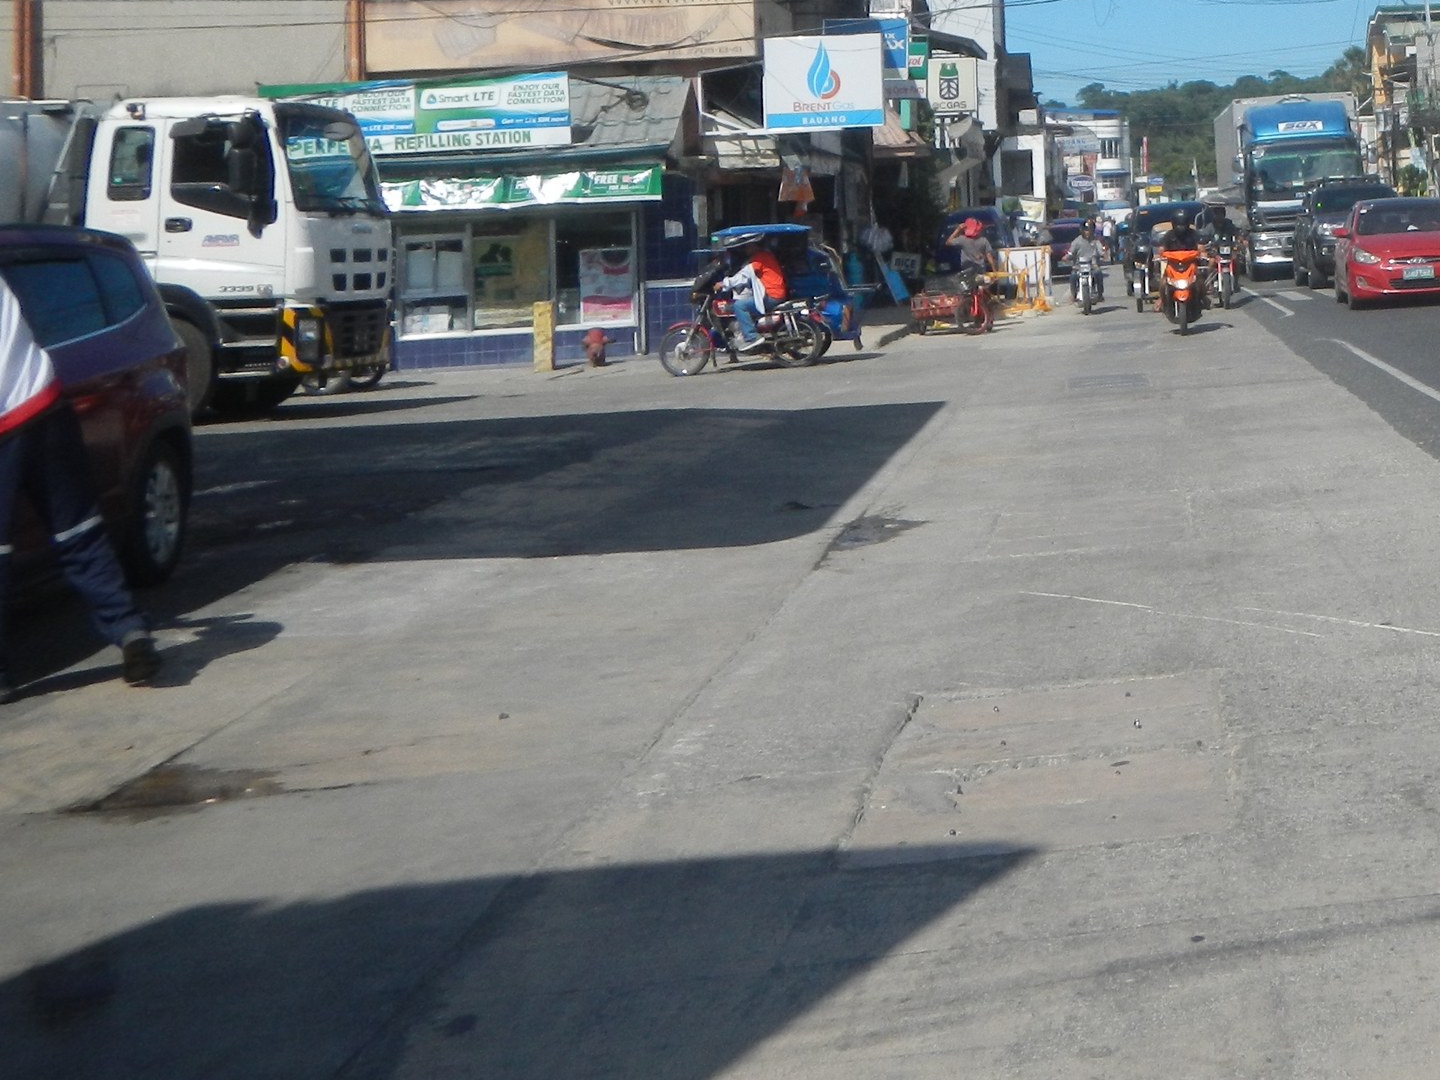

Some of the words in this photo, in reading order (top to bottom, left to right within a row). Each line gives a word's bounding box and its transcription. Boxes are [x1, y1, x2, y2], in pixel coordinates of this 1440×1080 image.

[513, 84, 540, 92] ENJOY
[438, 93, 470, 104] Smart
[473, 91, 495, 102] LTE
[507, 90, 543, 98] FASTEST
[543, 89, 566, 97] DATA
[506, 96, 566, 105] CONNECTION!
[801, 115, 848, 126] BAUANG
[394, 130, 472, 151] REFILLING
[475, 130, 532, 146] STATION
